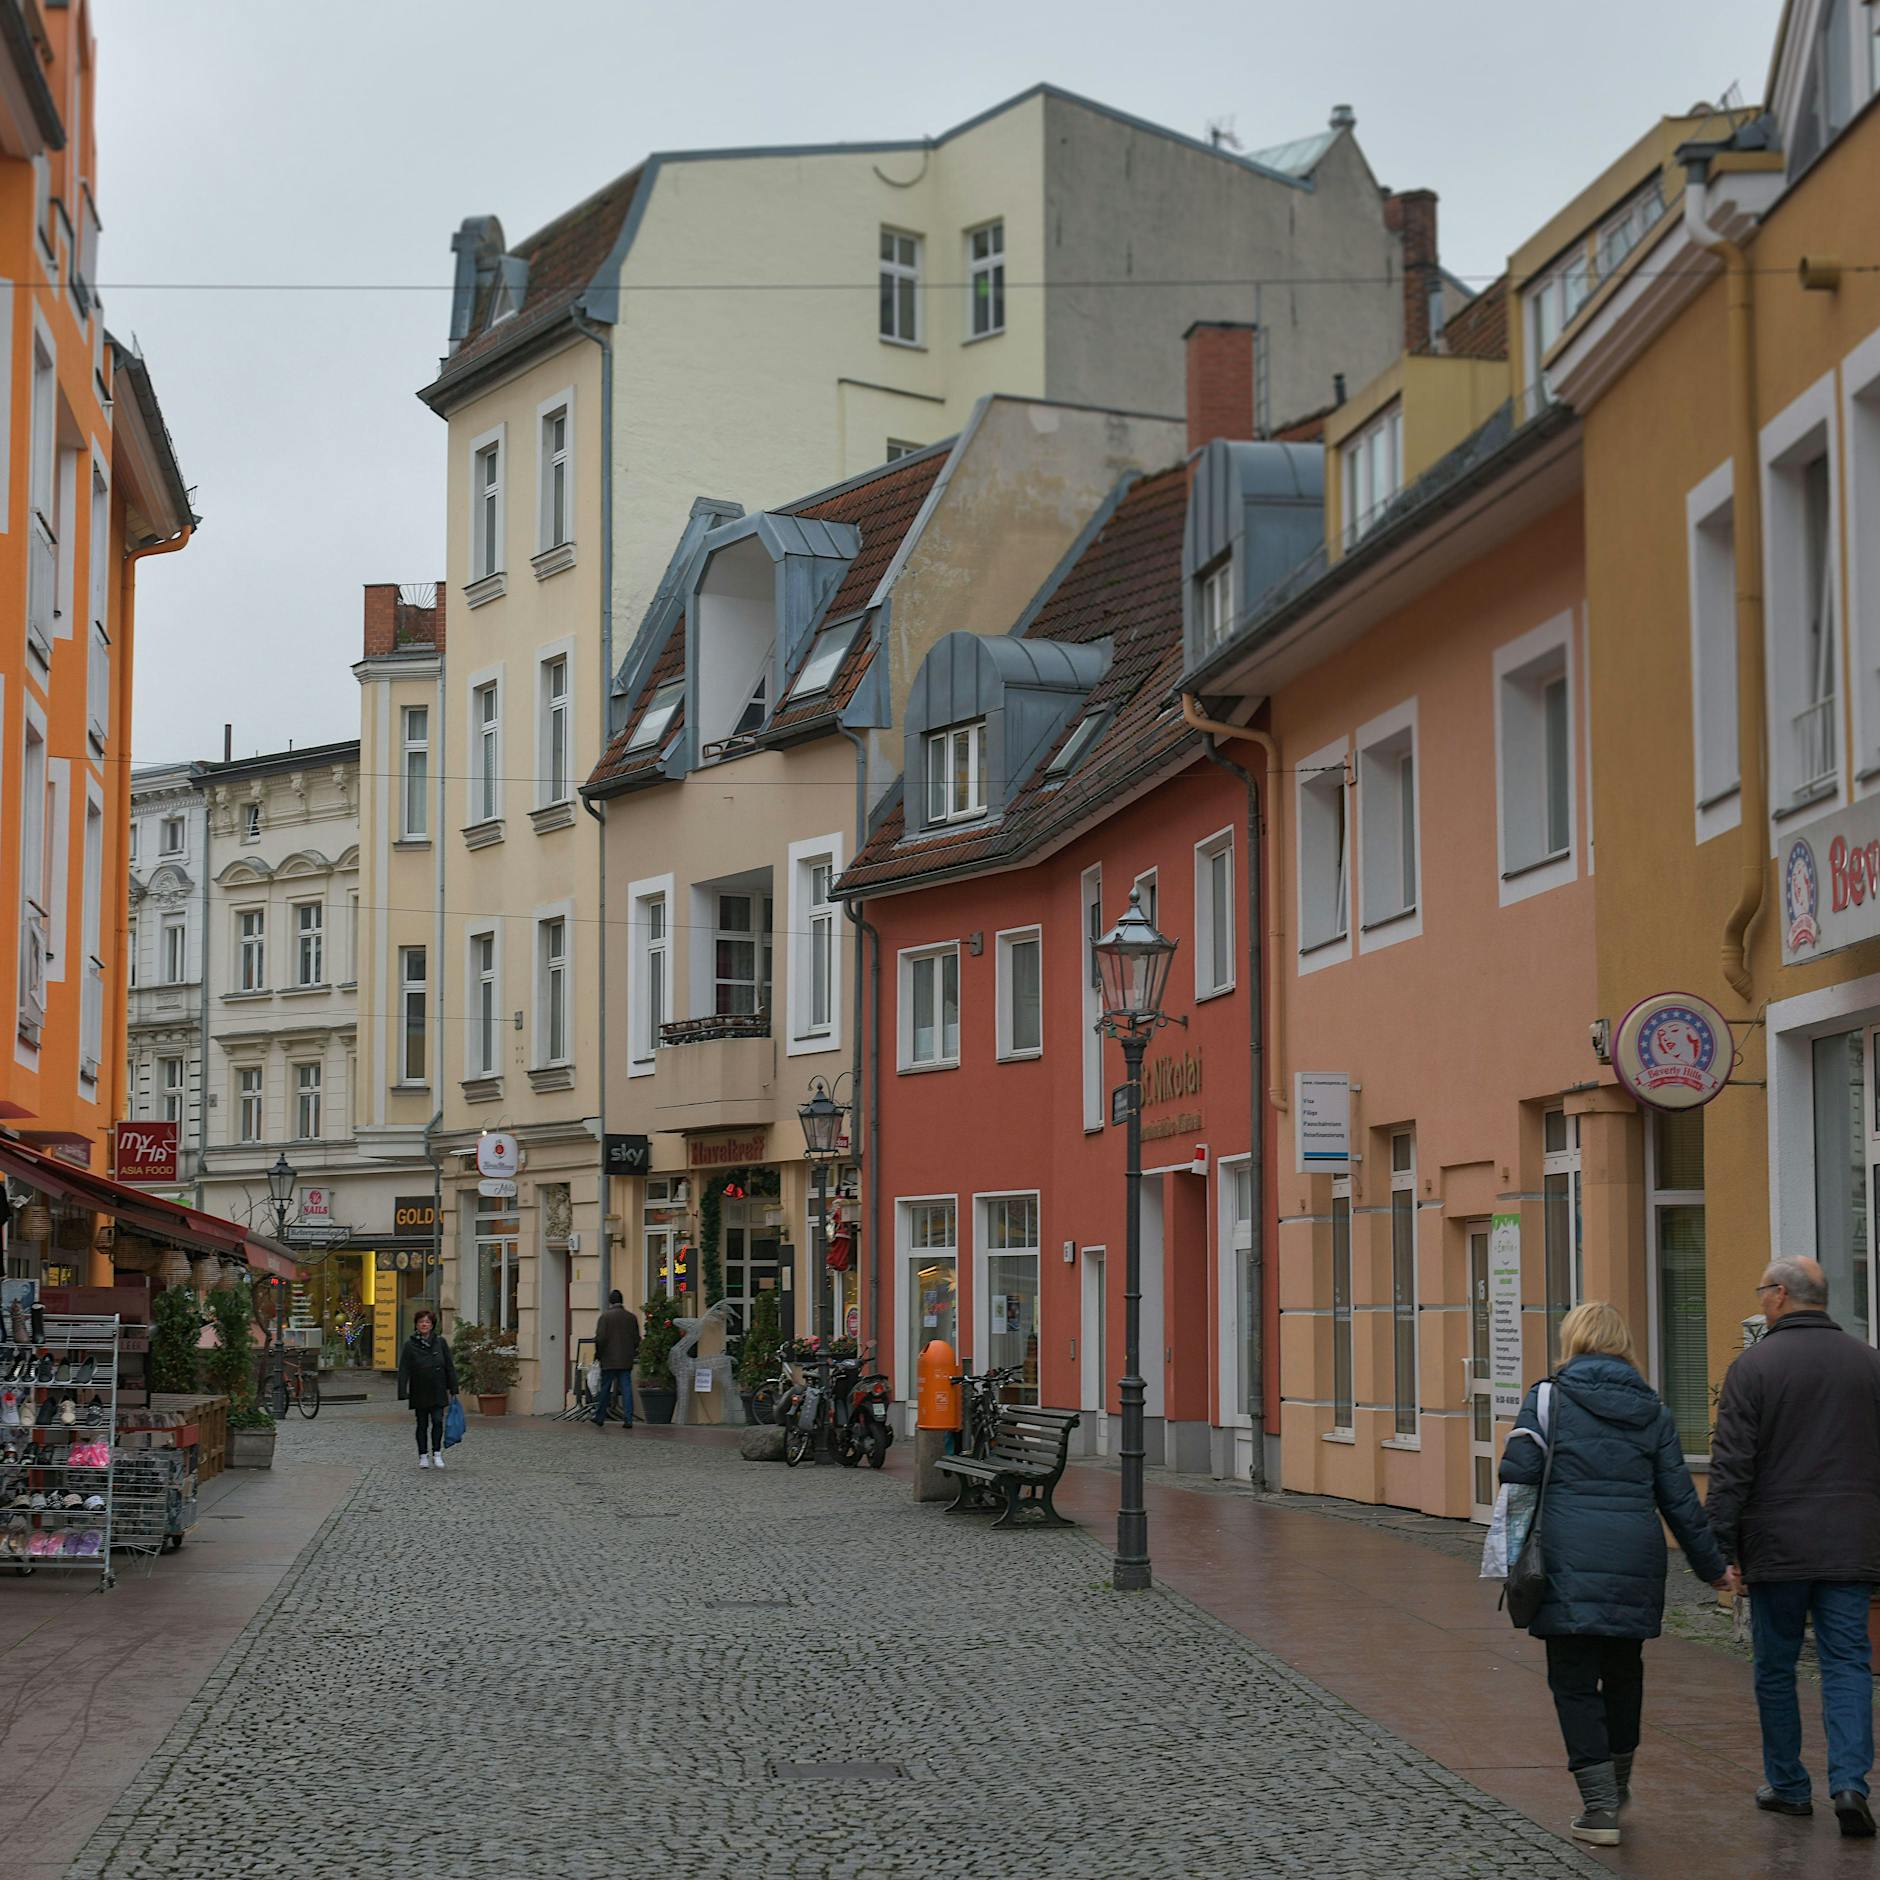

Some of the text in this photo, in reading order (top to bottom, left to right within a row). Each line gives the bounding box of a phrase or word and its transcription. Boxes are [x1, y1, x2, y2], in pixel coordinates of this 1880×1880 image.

[1829, 834, 1880, 913] Bev
[1152, 1044, 1202, 1102] Nikolai
[1648, 1066, 1703, 1081] Beverly Hills
[610, 1143, 644, 1167] sky
[120, 1166, 174, 1175] ASIA FOOD
[303, 1205, 329, 1215] NAILS
